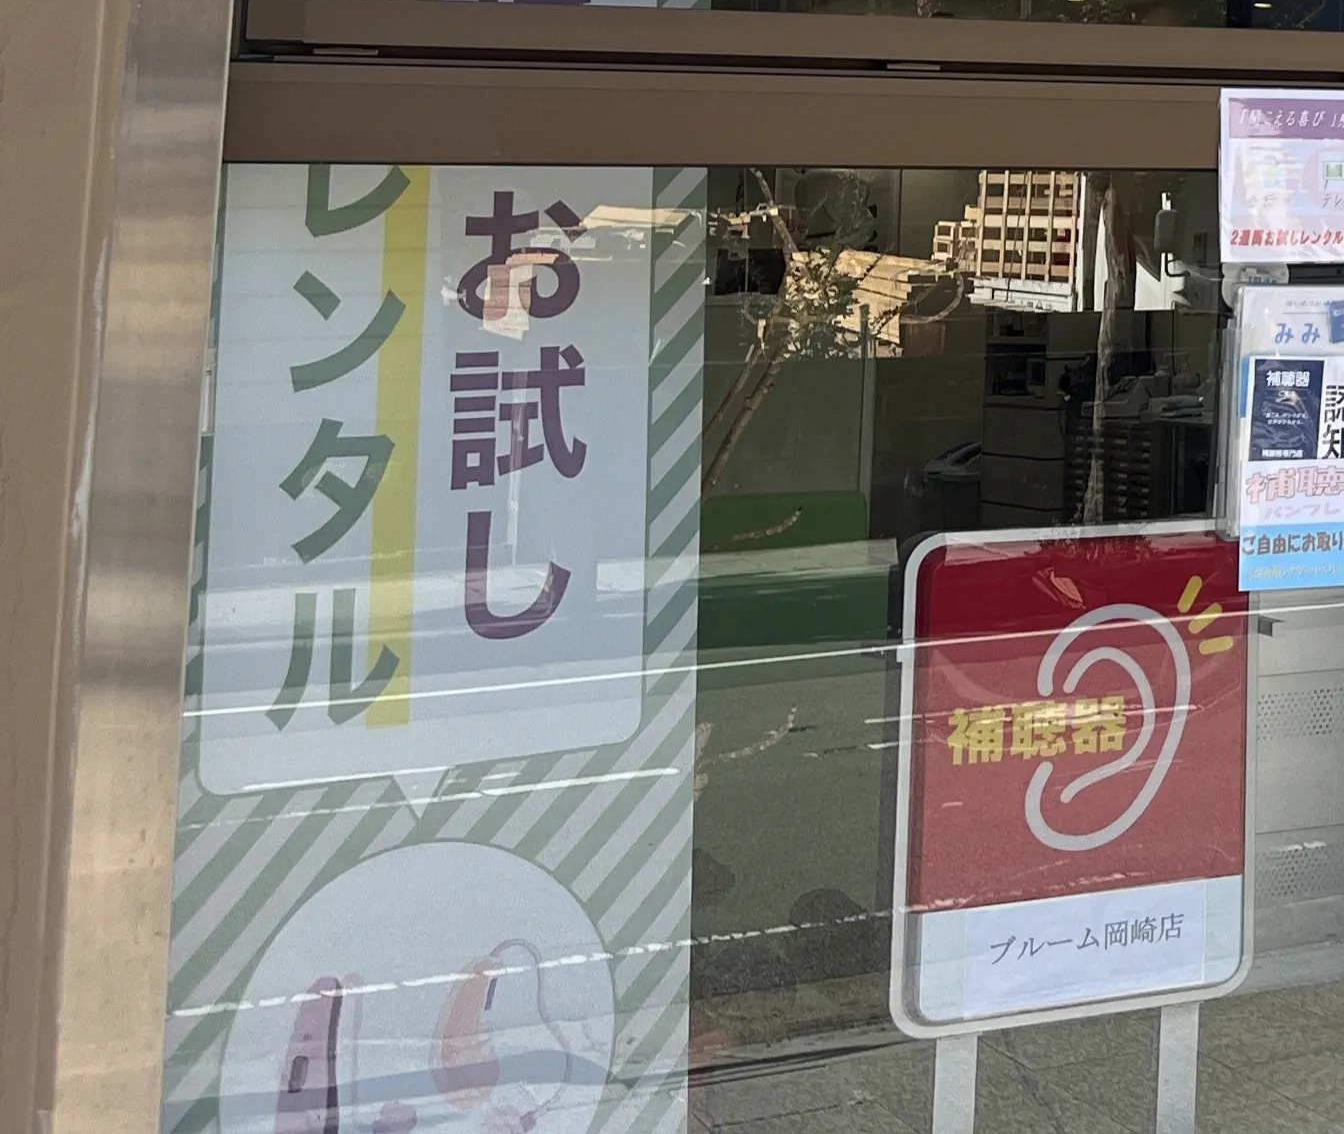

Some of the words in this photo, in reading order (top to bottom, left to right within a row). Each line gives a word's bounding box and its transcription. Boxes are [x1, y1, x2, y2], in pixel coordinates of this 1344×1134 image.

[449, 189, 589, 643] お試し
[947, 694, 1128, 766] 補聴器
[989, 912, 1186, 965] ブルーム岡崎店
